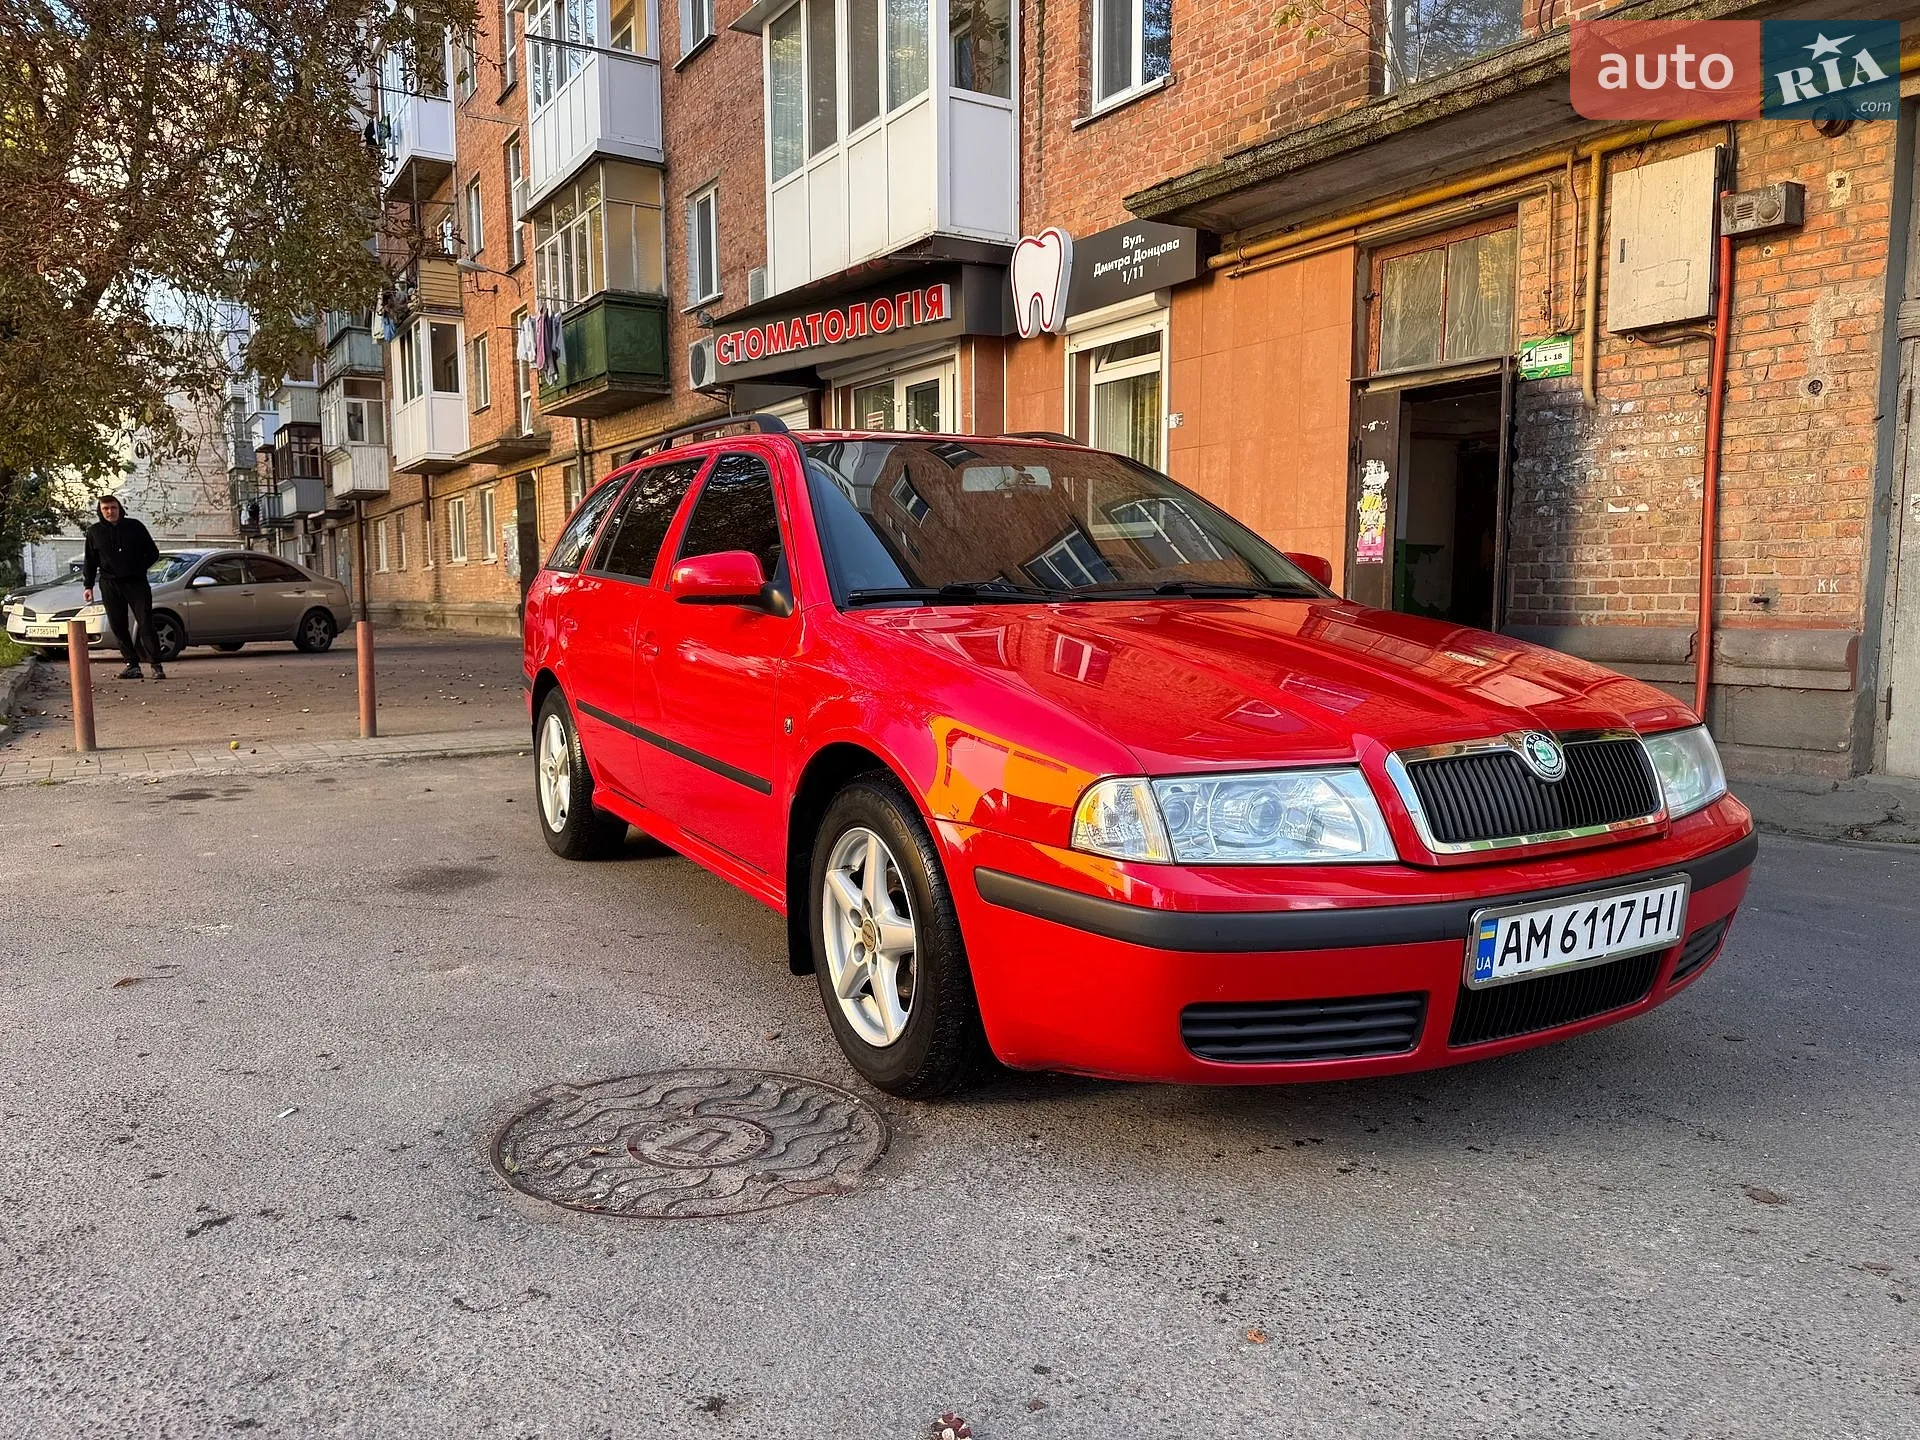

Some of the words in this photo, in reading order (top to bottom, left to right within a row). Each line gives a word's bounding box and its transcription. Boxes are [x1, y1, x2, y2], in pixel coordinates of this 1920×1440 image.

[1122, 234, 1145, 249] Вул.
[1093, 254, 1131, 278] Дмитра
[1132, 238, 1180, 265] Донцова
[1122, 265, 1144, 285] 1/11
[715, 283, 948, 366] СТОМАТОЛОГІЯ
[1476, 956, 1492, 971] UA
